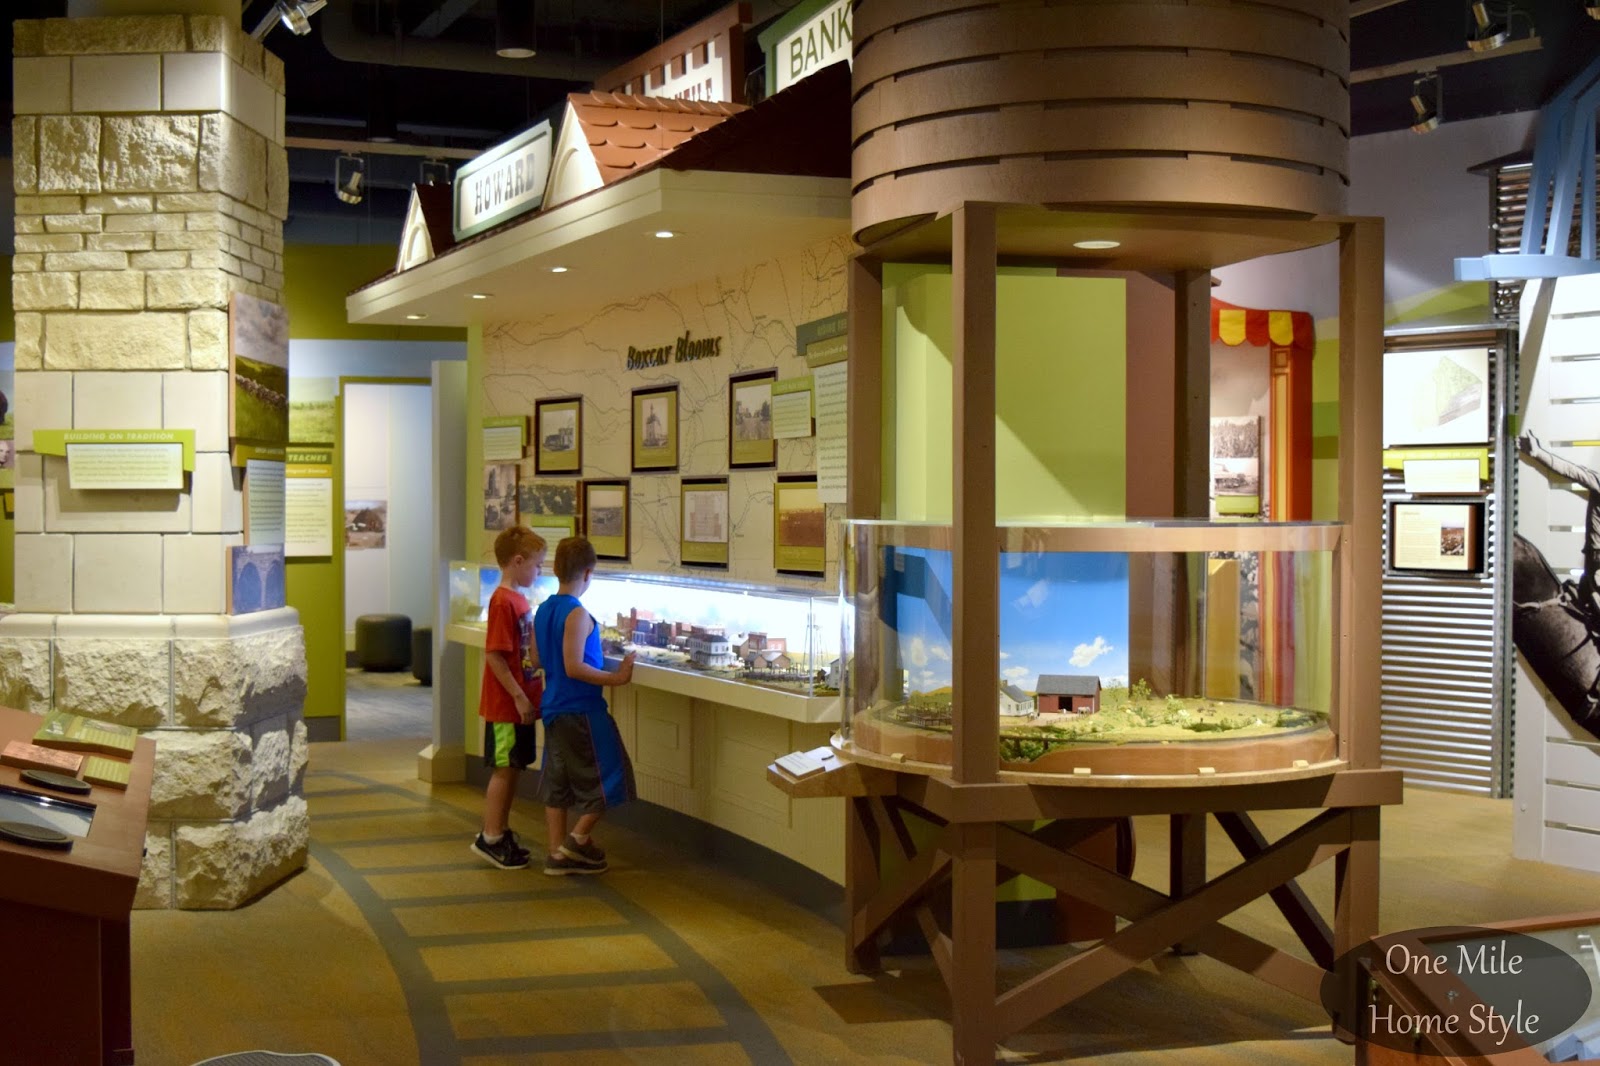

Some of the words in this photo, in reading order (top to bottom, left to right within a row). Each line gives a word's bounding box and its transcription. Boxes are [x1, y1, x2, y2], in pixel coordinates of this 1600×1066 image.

[790, 0, 852, 80] BANK
[474, 153, 535, 215] HOWARD
[626, 345, 673, 370] Boxcar
[675, 330, 722, 363] Blooms
[63, 432, 106, 441] BUILDING
[108, 432, 124, 441] ON
[126, 432, 175, 441] TRADITION
[287, 453, 328, 463] TEACHES
